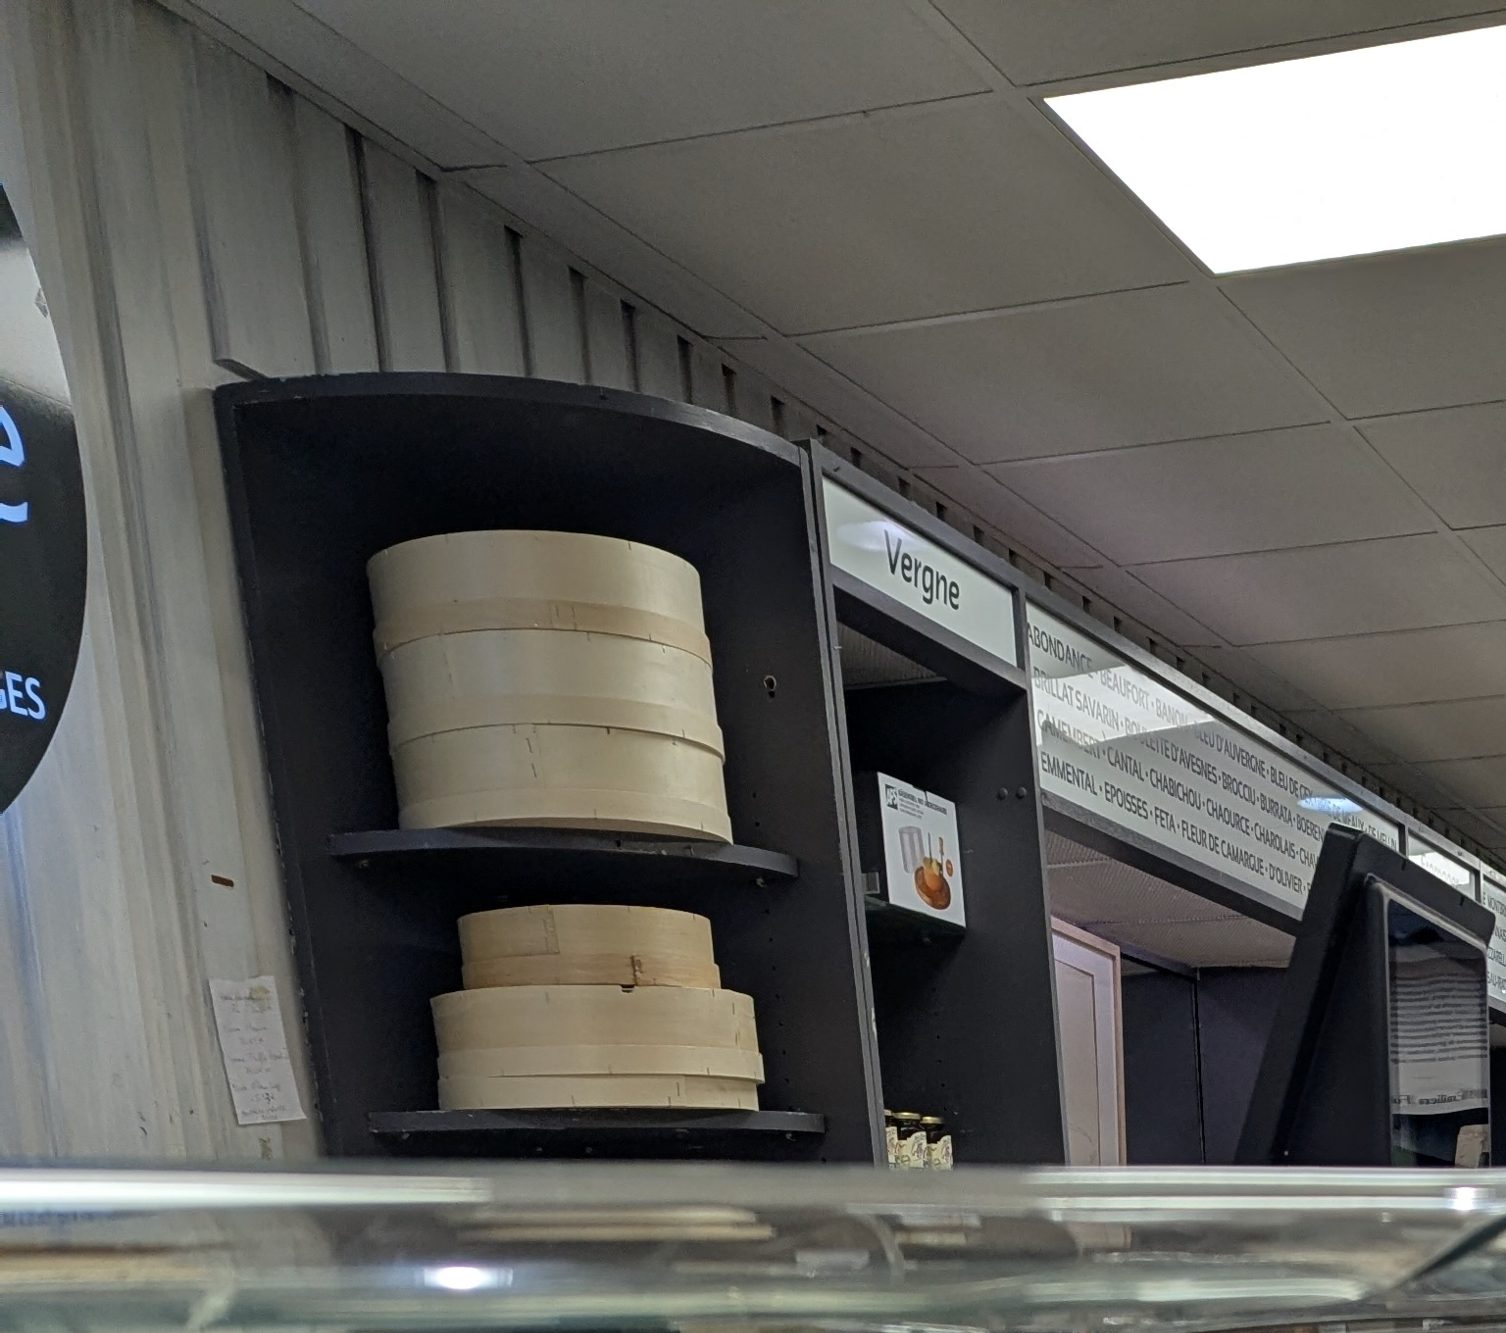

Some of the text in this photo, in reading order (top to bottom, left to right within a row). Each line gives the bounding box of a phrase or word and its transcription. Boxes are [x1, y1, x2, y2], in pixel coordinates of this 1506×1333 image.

[884, 529, 960, 610] Vergne
[1033, 666, 1073, 705] BRILLAT
[1076, 691, 1120, 731] SAVARIN
[1171, 743, 1218, 784] D'AVESNES
[1260, 792, 1293, 827] BURRATA
[1100, 671, 1149, 711] BEAUFORT
[1216, 737, 1266, 779] D'AUVERGNE
[1270, 766, 1288, 791] BLEU
[1289, 777, 1299, 798] DE
[1041, 751, 1097, 796] EMMENTAL
[1104, 781, 1149, 820] EPOISSES
[1154, 806, 1176, 834] FETA
[1181, 820, 1208, 850] FLEUR
[1208, 835, 1220, 854] DE
[1220, 840, 1264, 876] CAMARGUE
[1269, 863, 1302, 894] D'OLIVIER
[1107, 746, 1145, 782] CANTAL
[1150, 768, 1202, 811] CHABICHOU
[1206, 798, 1250, 836] CHAOURCE
[1254, 822, 1296, 859] CHAROLAIS
